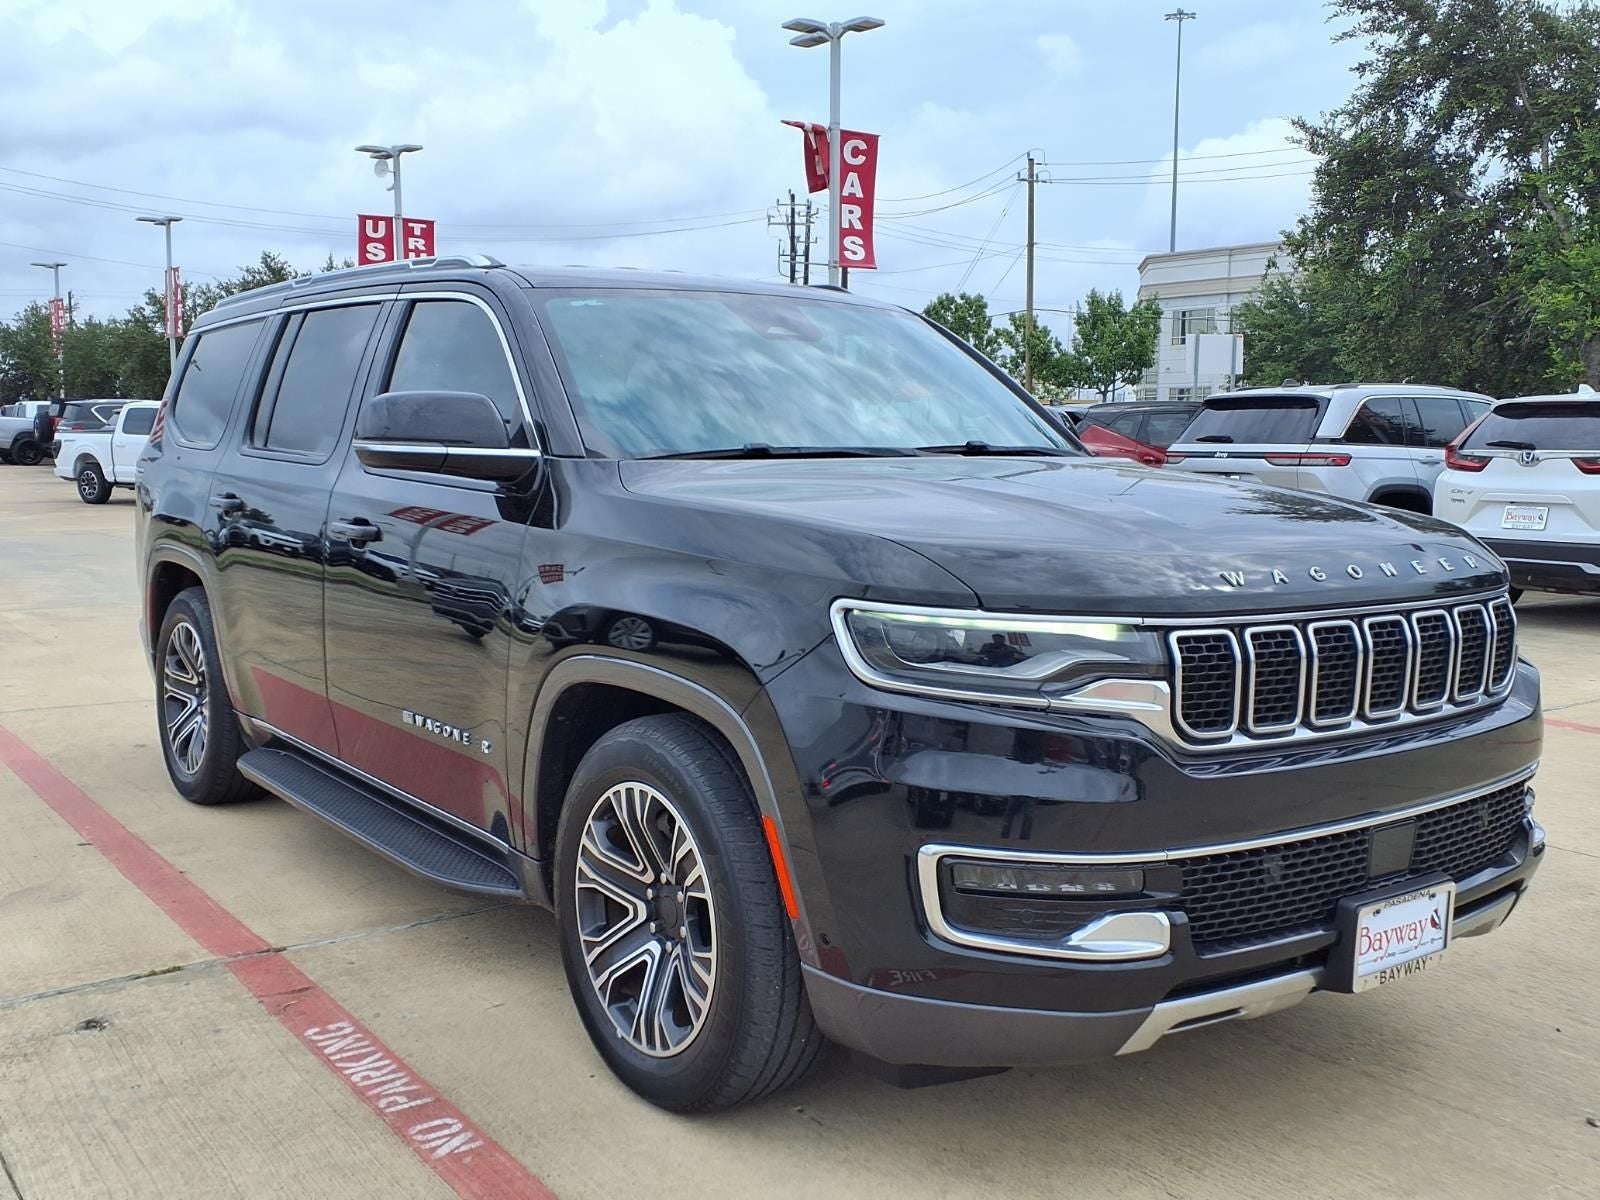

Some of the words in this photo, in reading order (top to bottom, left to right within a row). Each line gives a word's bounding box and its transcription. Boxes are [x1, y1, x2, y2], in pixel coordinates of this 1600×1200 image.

[841, 139, 868, 261] CARS
[1220, 554, 1478, 588] WAGONEER
[1383, 889, 1431, 909] PASADENA
[1359, 917, 1429, 961] Bayway
[1379, 956, 1428, 985] BAYWAY
[304, 1020, 435, 1113] PARKING
[408, 1117, 484, 1159] NO
